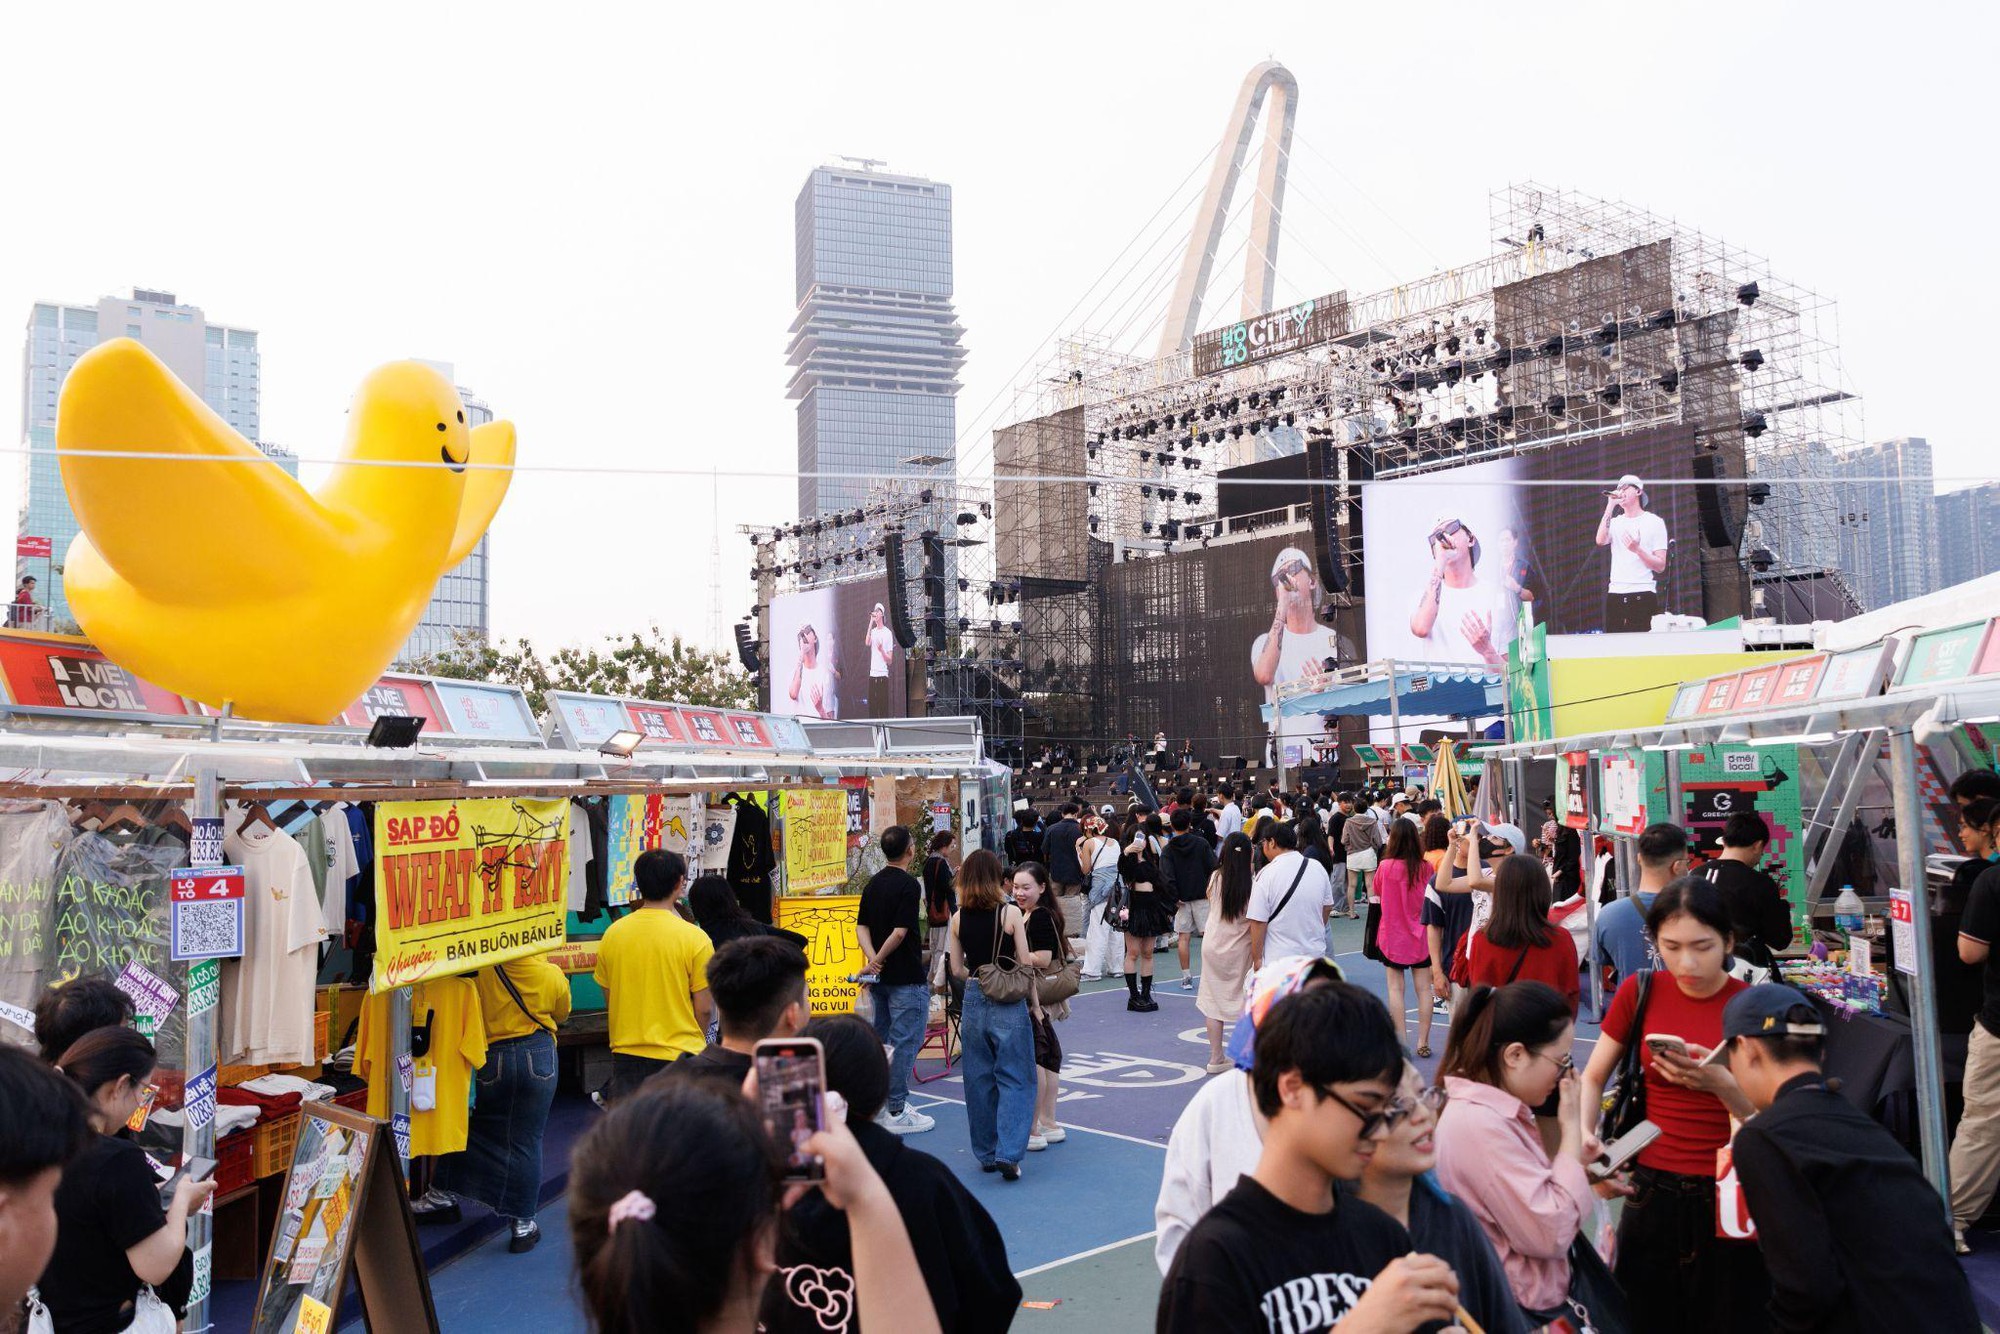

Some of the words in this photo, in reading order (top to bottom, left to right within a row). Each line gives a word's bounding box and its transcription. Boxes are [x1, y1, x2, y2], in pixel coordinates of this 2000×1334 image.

[59, 684, 148, 710] LOCAL
[387, 816, 427, 846] SẠP
[429, 804, 460, 838] ĐỒ
[209, 878, 229, 896] 4
[383, 848, 477, 930] WHAT
[1900, 903, 1908, 919] 7
[480, 931, 519, 955] BUÔN
[830, 1001, 849, 1011] VUI
